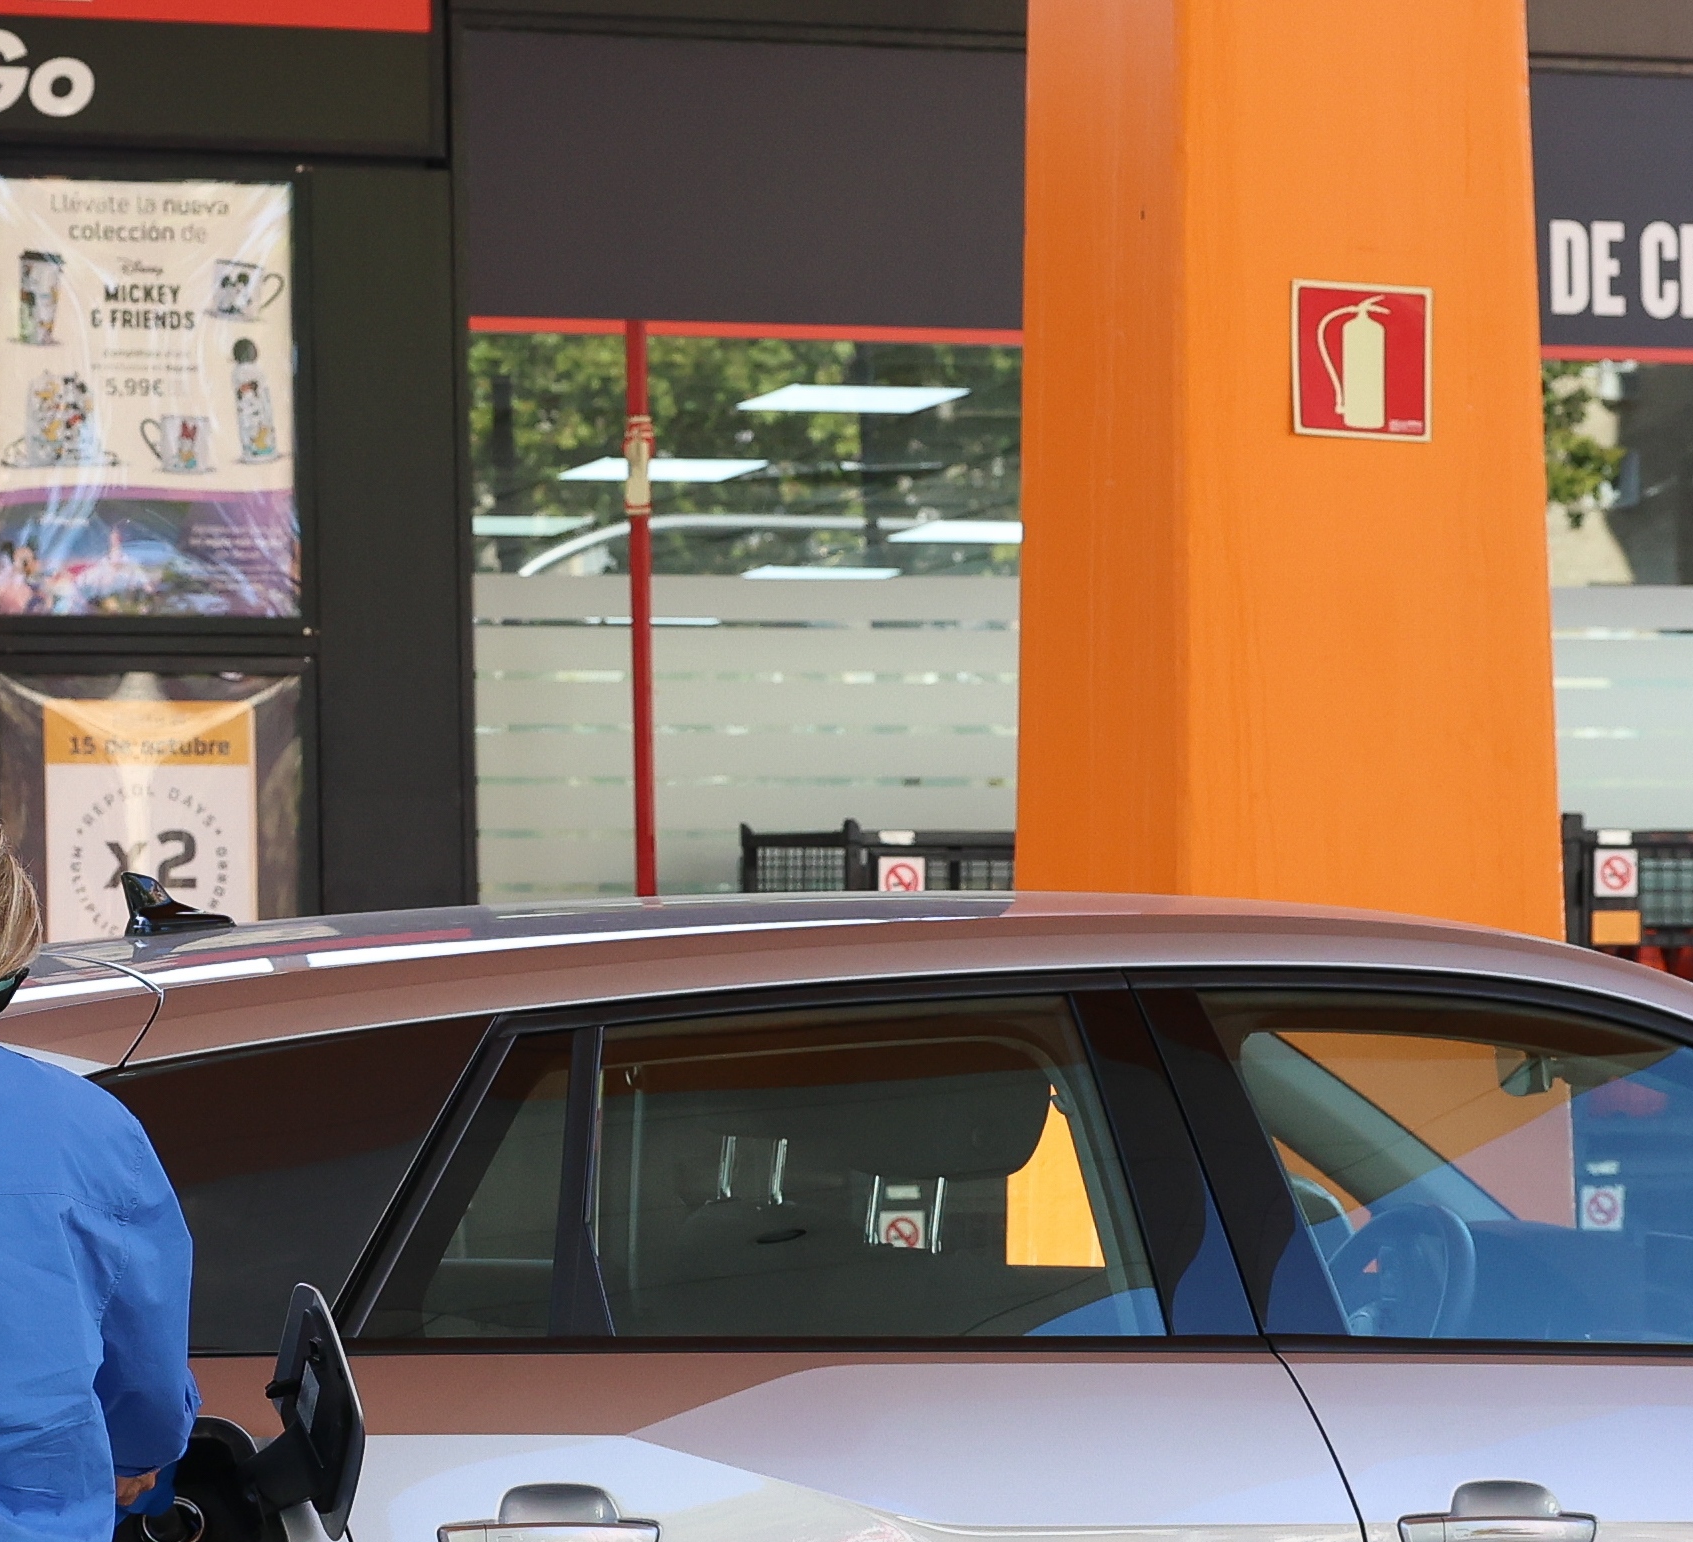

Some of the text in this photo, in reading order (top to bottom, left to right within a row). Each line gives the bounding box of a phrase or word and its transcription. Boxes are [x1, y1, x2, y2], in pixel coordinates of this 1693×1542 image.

[163, 197, 231, 217] nueva
[68, 220, 207, 244] colección de
[1548, 218, 1627, 319] DE
[104, 284, 182, 305] MICKEY
[110, 309, 195, 330] FRIENDS
[69, 735, 96, 756] 15
[140, 736, 230, 757] octubre
[168, 786, 217, 828] DAYS
